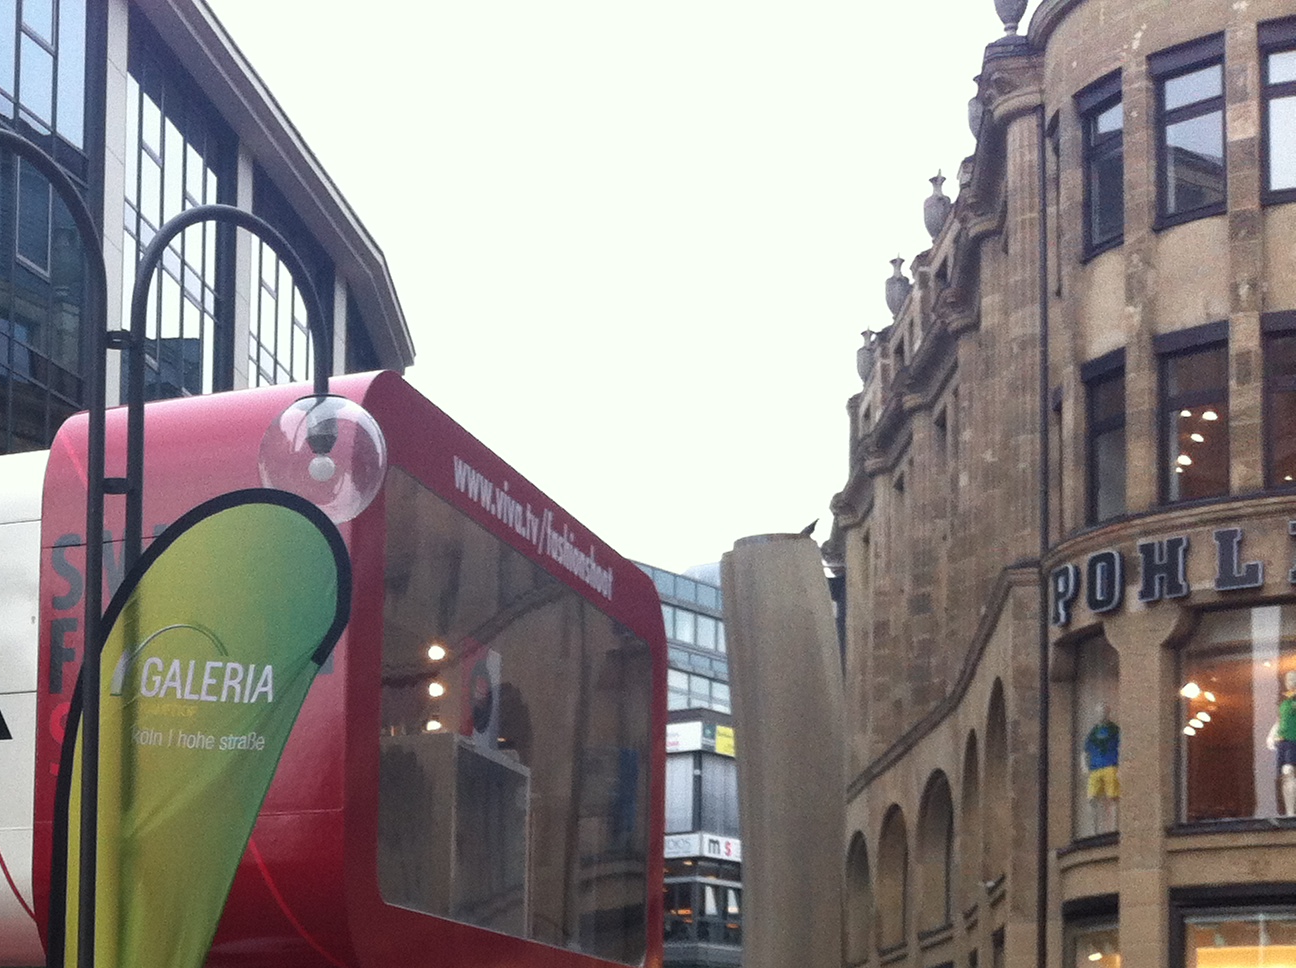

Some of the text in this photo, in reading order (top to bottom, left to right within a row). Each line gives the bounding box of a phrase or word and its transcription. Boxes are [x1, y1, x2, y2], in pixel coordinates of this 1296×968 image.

[1051, 520, 1296, 627] POHL
[140, 656, 274, 704] GALERIA
[177, 730, 215, 750] hohe
